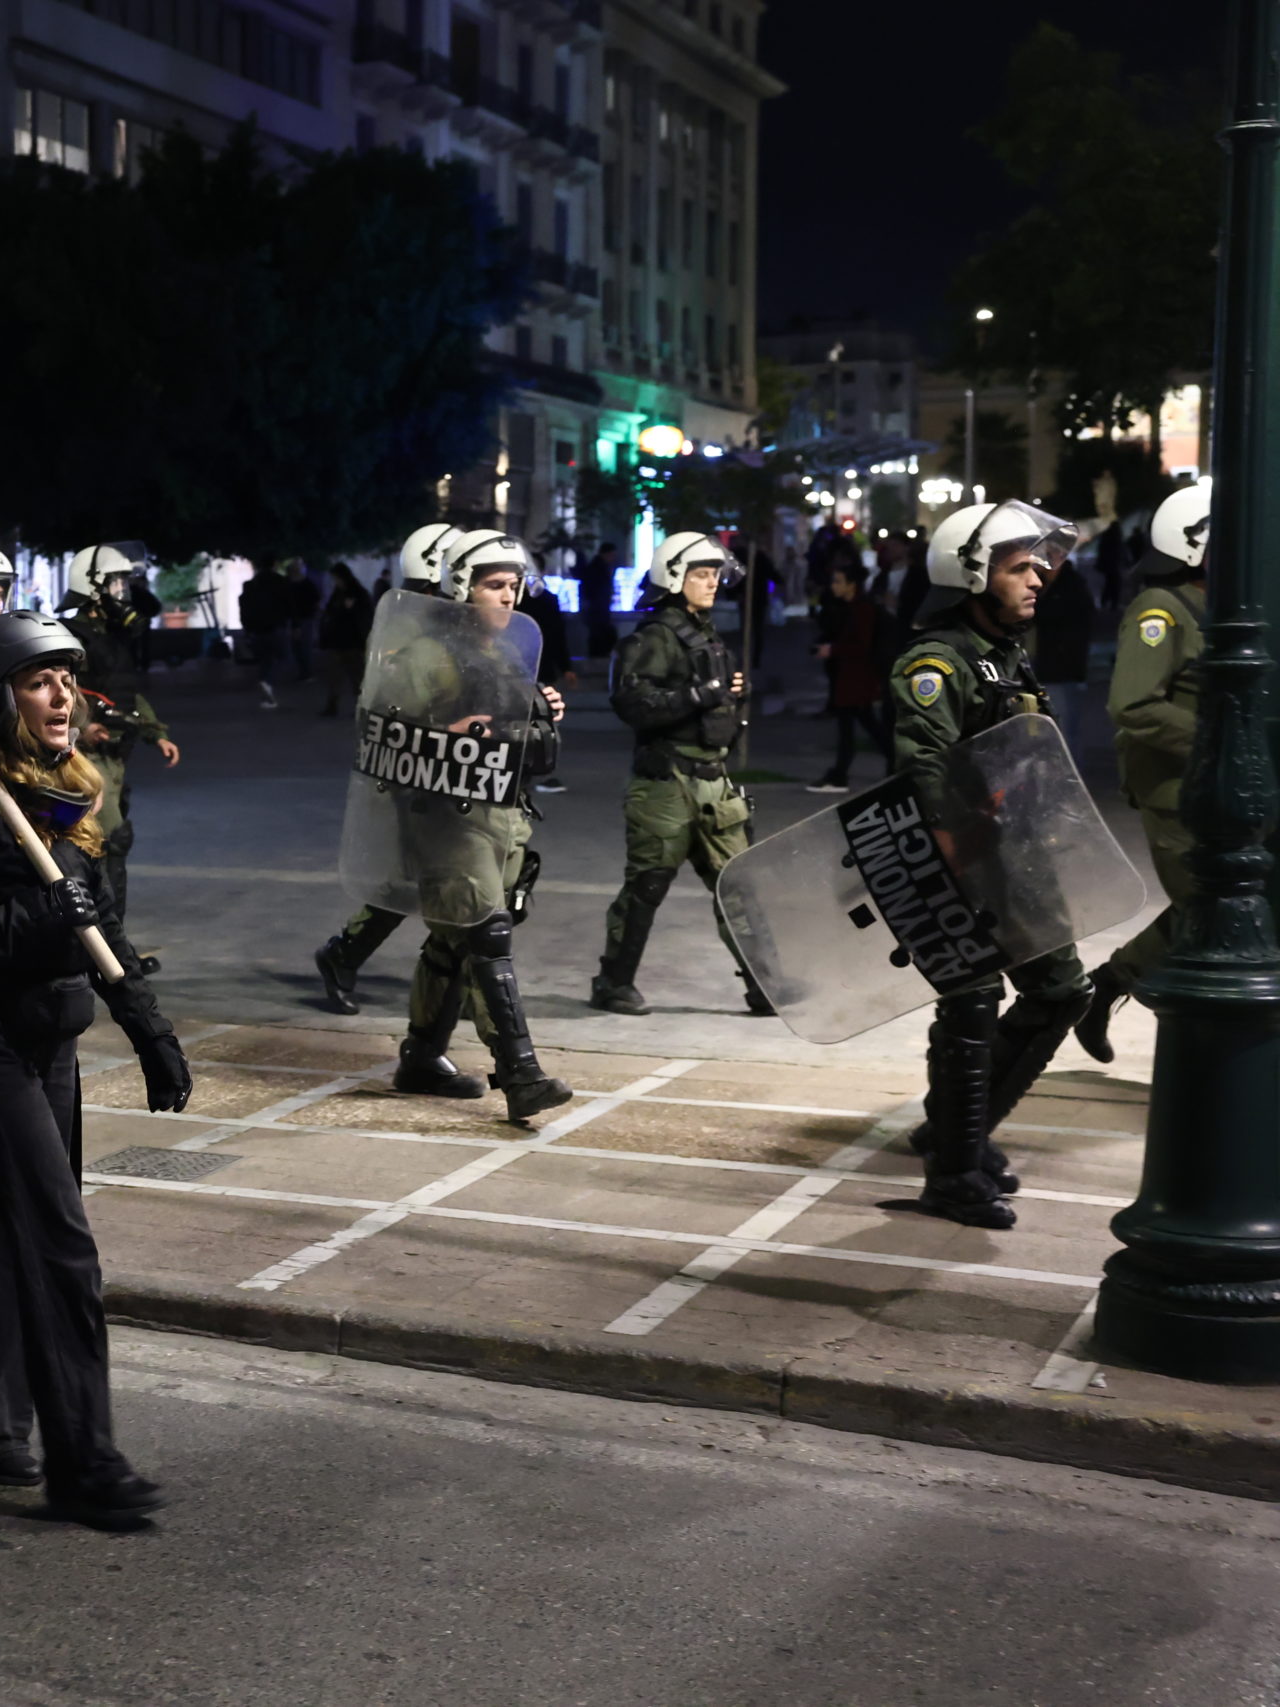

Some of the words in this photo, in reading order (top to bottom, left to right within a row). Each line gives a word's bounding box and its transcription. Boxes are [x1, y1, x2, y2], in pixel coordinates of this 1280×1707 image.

[358, 738, 514, 803] ΑΣΤΥΝΟΜΙΑ
[366, 716, 510, 770] POLICE
[846, 801, 973, 984] ΑΣΤΥΝΟΜΙΑ
[885, 796, 1000, 973] POLICE
